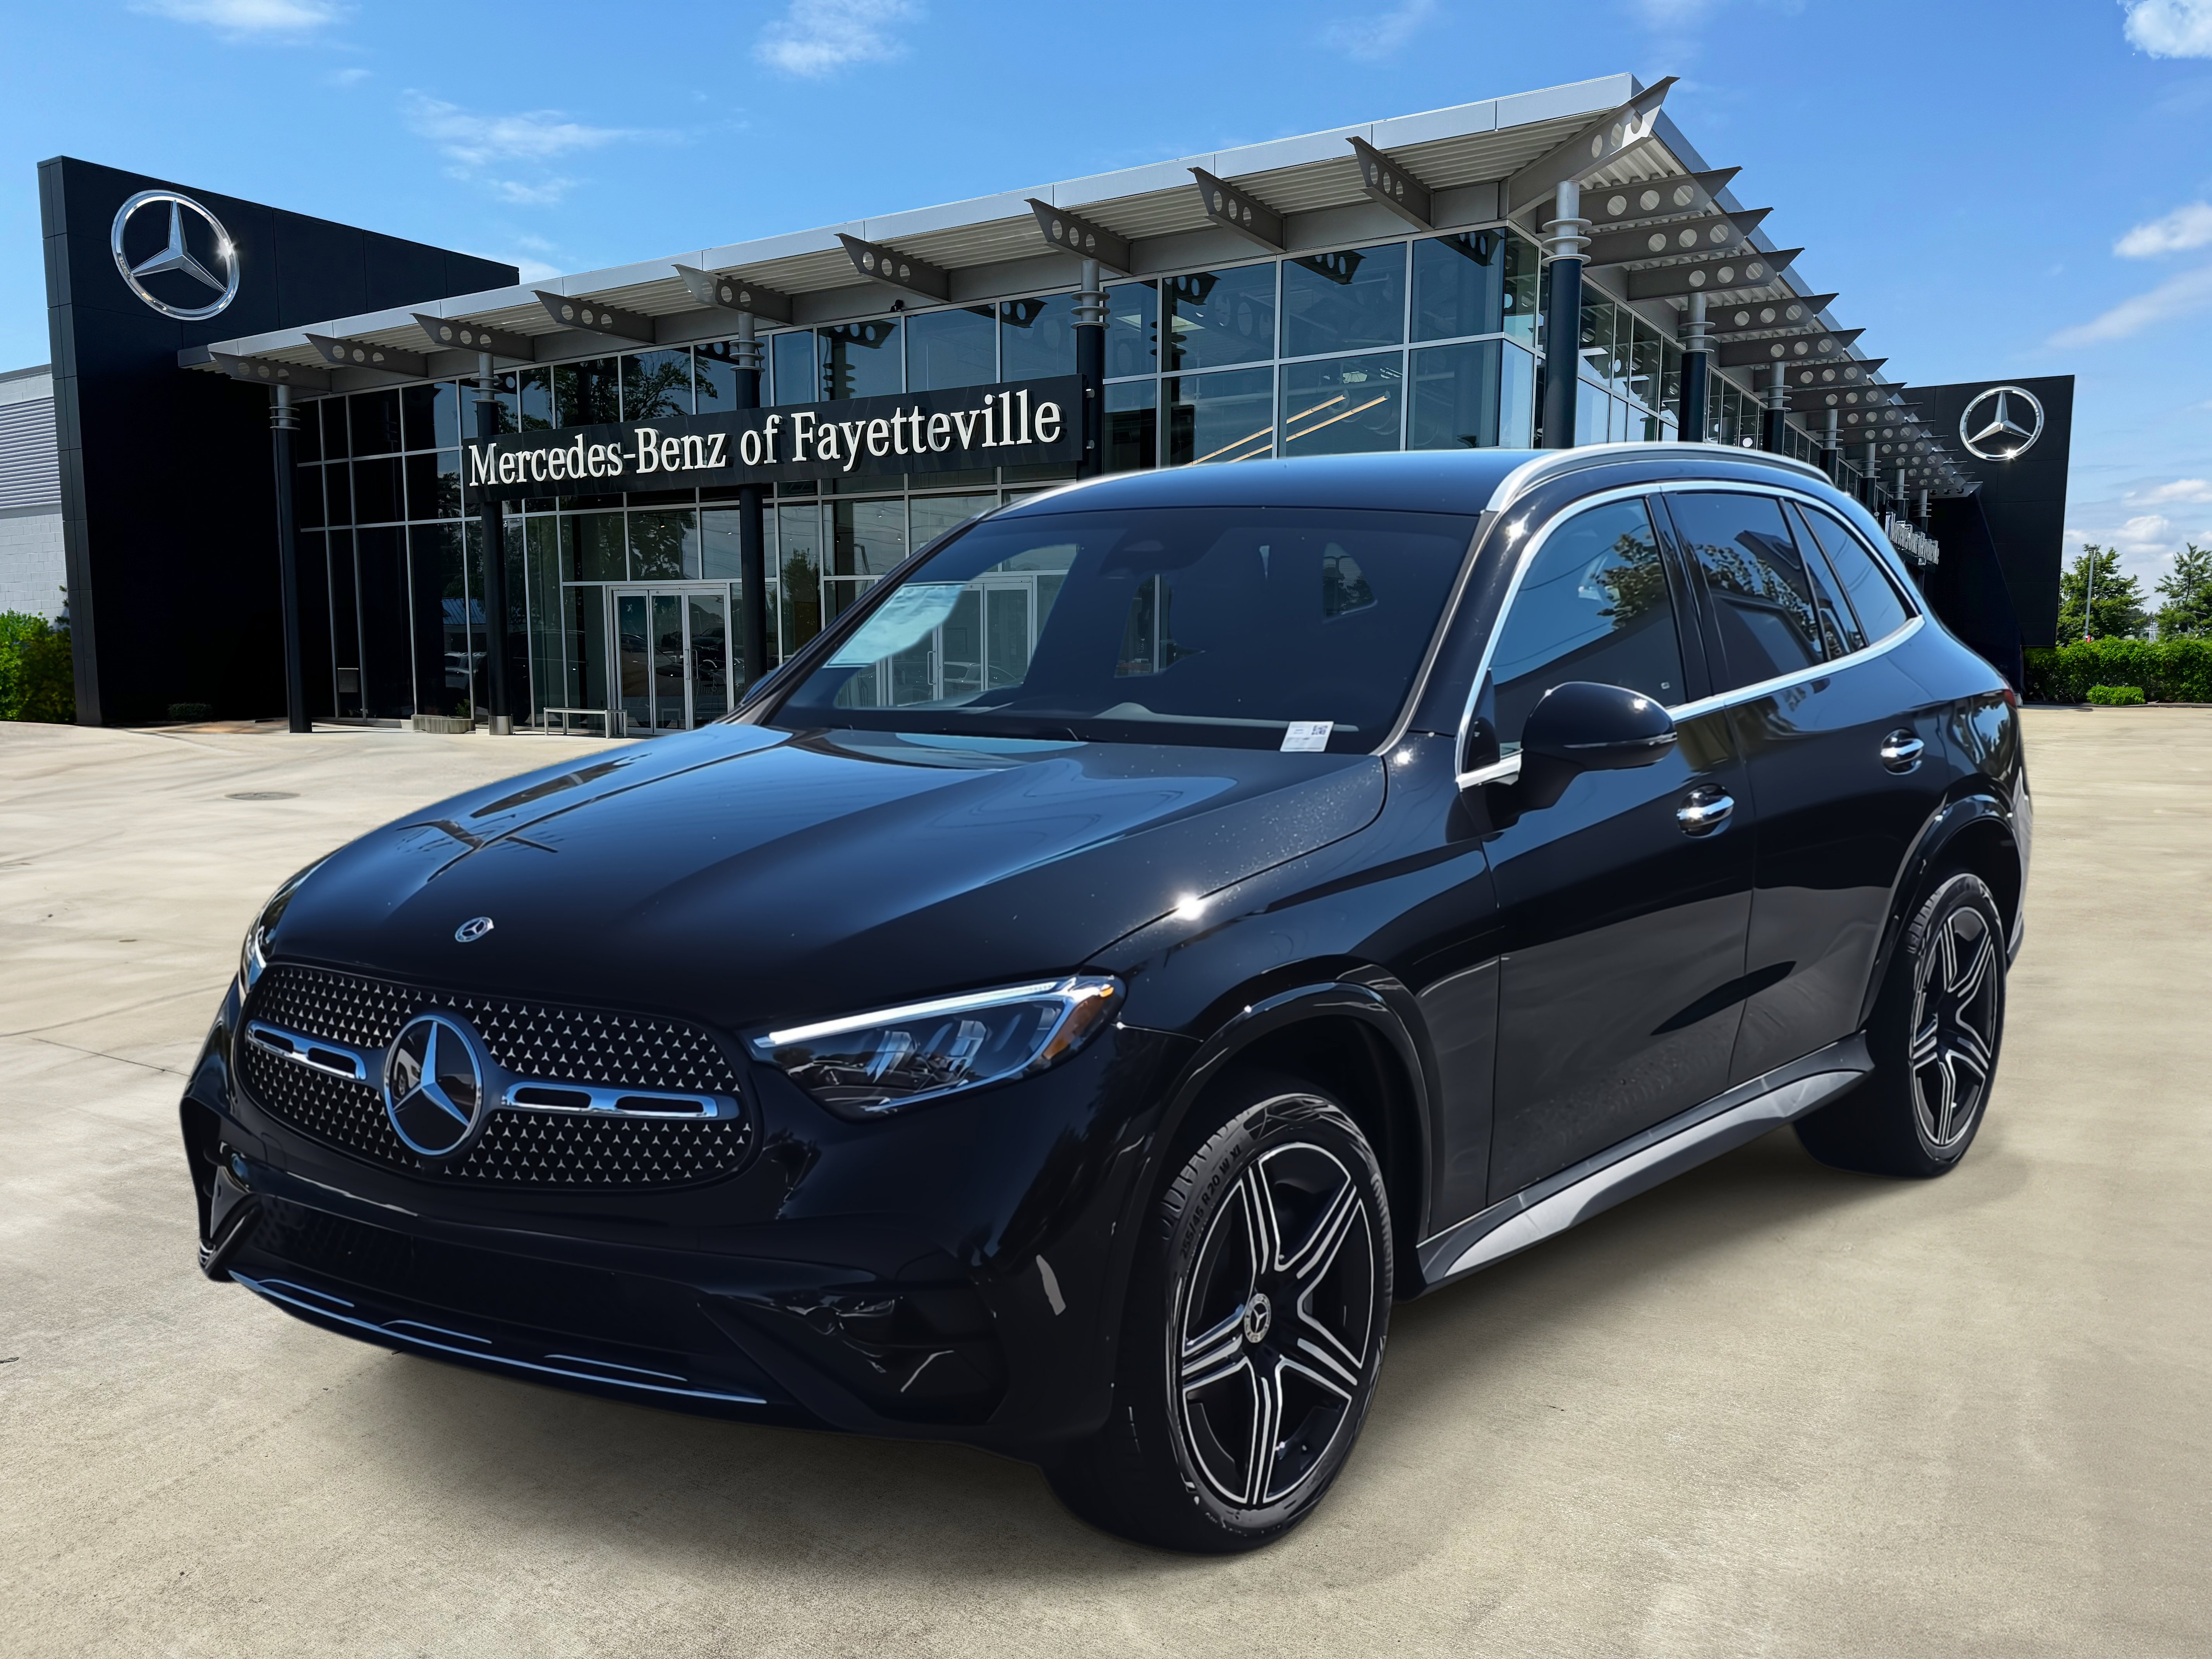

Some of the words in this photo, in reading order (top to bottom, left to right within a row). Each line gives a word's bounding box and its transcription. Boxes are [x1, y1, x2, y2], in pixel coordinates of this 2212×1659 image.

[468, 427, 726, 486] Mercedes-Benz
[740, 414, 780, 466] of
[791, 388, 1061, 472] Fayetteville
